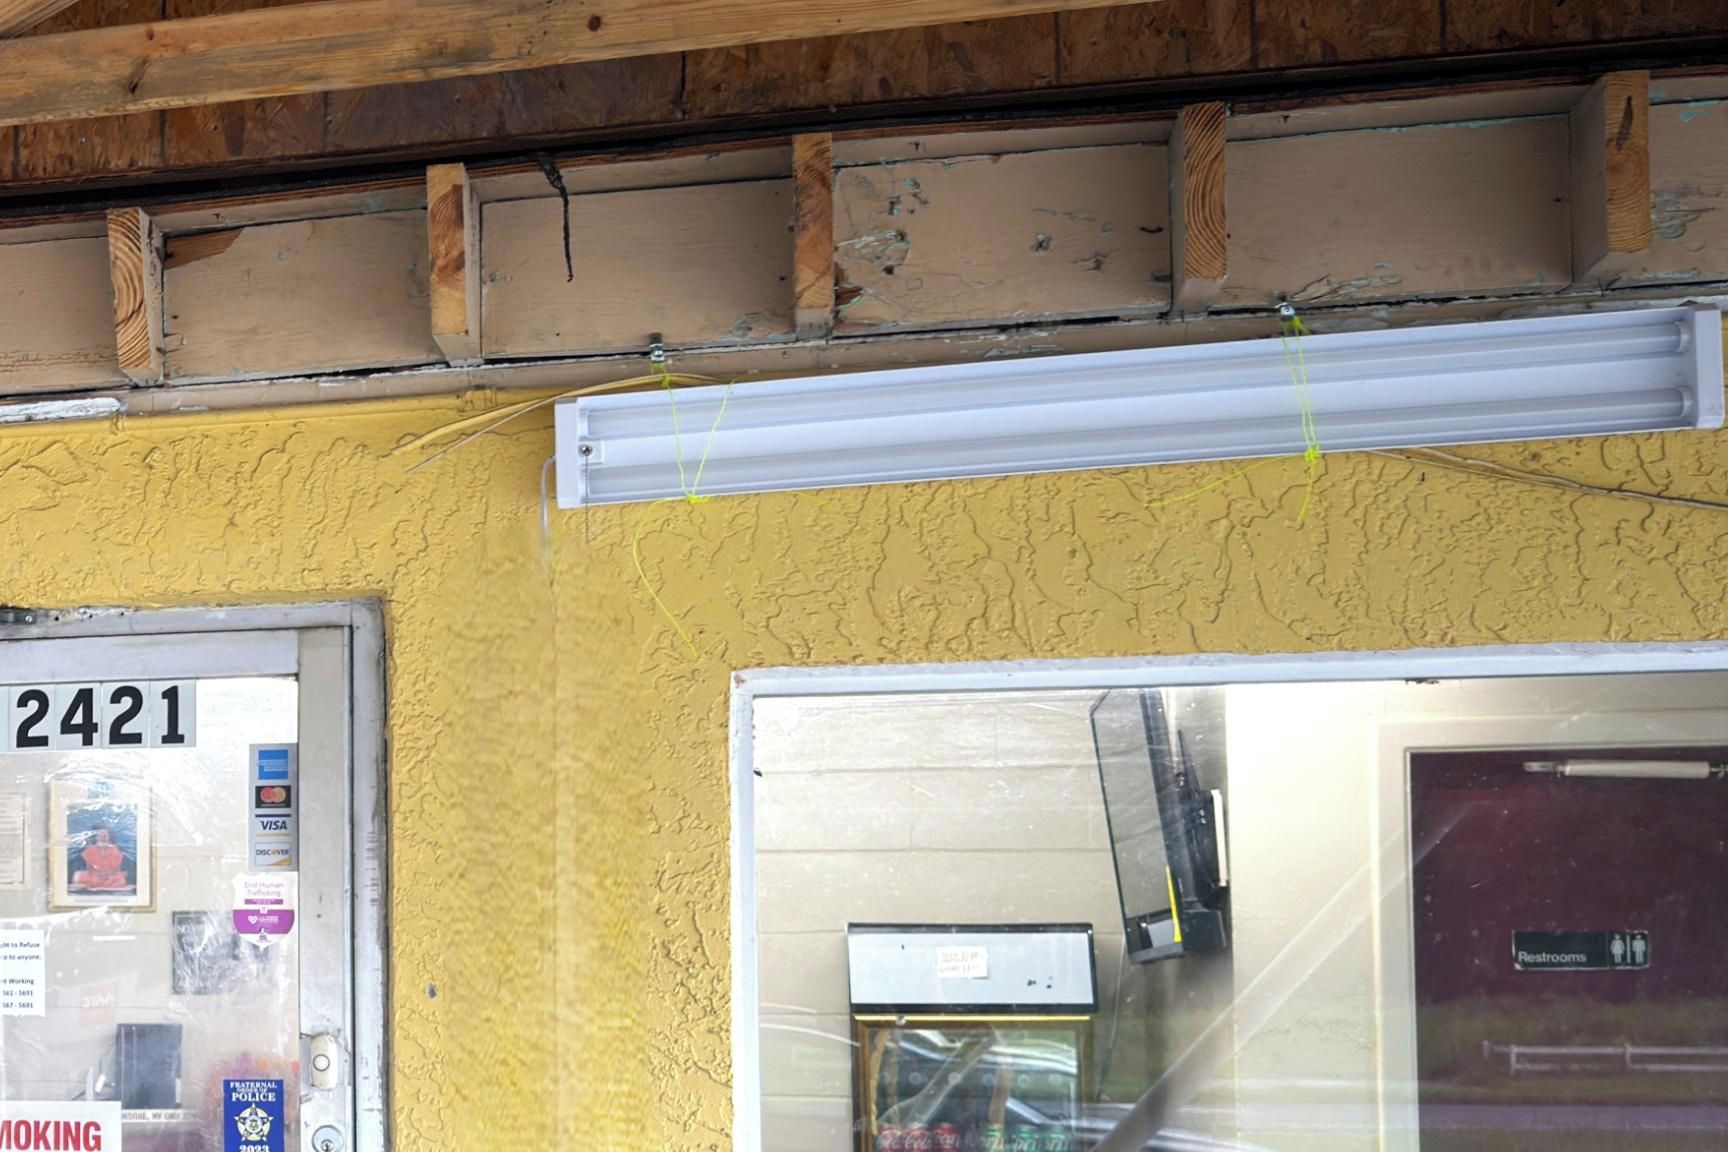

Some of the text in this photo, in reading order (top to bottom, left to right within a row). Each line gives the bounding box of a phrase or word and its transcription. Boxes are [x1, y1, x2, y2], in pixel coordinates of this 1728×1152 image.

[260, 820, 288, 831] VISA
[256, 849, 289, 857] DISCOVER
[247, 890, 281, 898] Trafficking
[19, 941, 40, 949] Refuse
[1518, 951, 1587, 962] Restrooms
[9, 978, 34, 986] Working
[230, 1081, 278, 1089] FRATERNAL
[231, 1092, 277, 1102] POLICE
